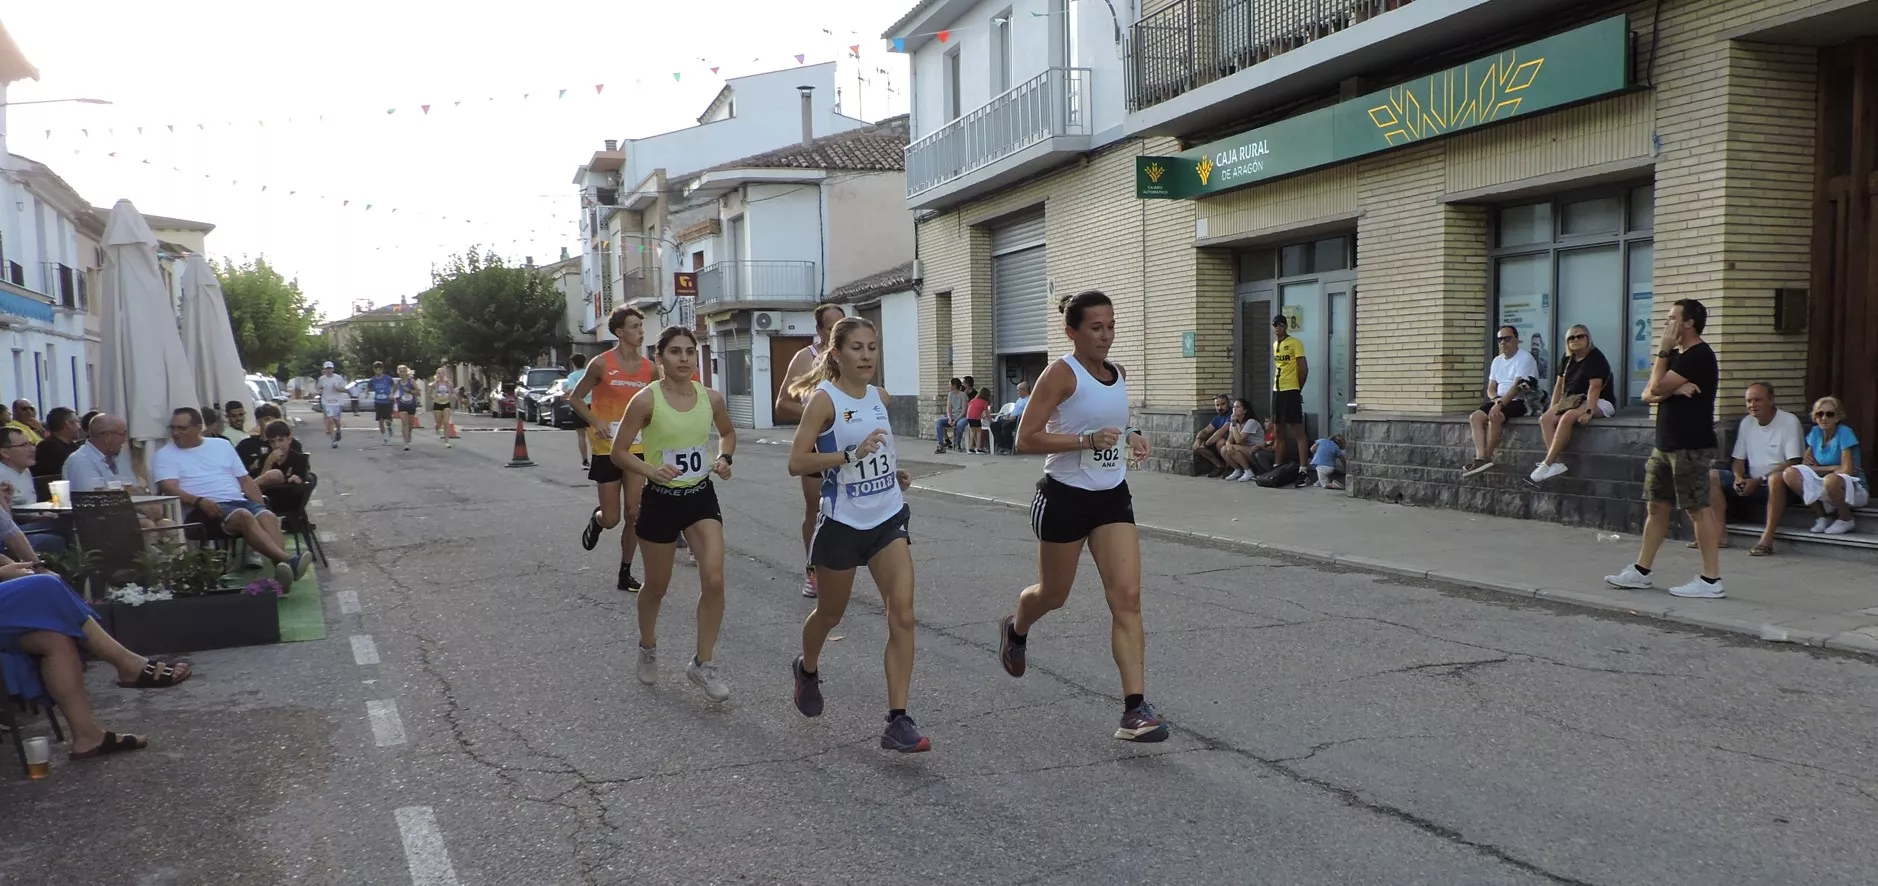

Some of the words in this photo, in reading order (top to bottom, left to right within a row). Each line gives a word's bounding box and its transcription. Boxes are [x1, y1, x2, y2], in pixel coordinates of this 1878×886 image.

[1216, 149, 1238, 167] CAJA
[1239, 139, 1270, 161] RURAL
[1221, 169, 1232, 181] DE
[1232, 160, 1264, 178] ARAGÓN
[675, 451, 702, 473] 50
[1093, 448, 1118, 461] 502
[855, 454, 890, 480] 113
[651, 484, 682, 497] NIKE
[683, 481, 707, 497] PRO
